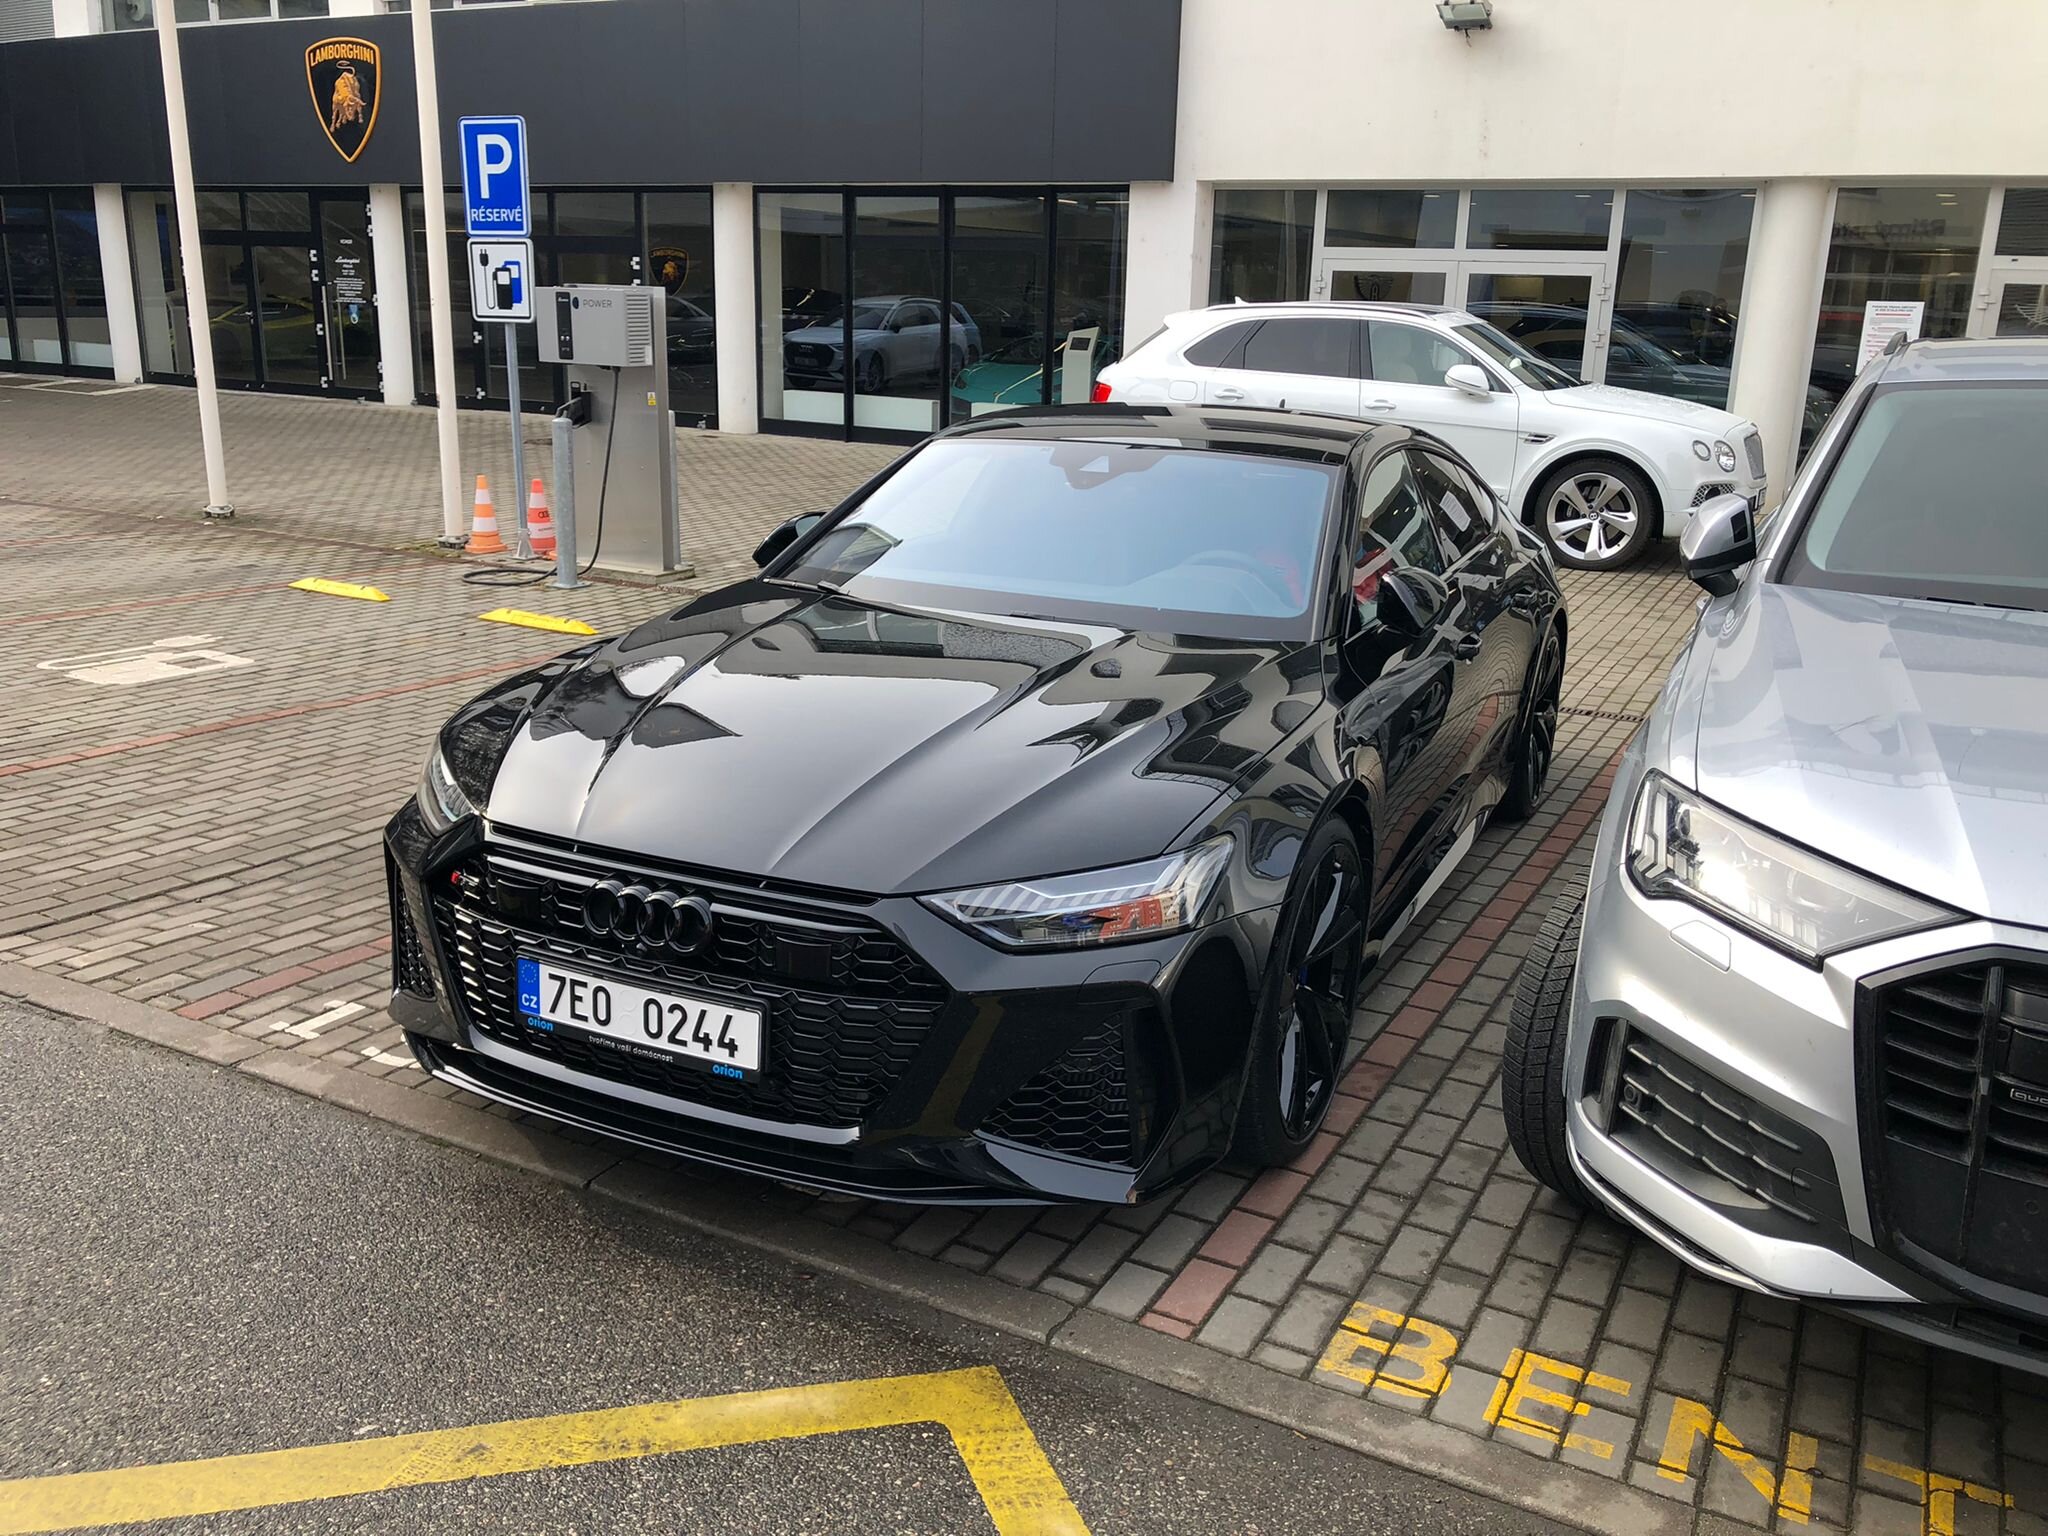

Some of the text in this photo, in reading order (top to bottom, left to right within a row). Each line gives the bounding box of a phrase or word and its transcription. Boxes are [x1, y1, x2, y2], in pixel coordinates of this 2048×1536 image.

[310, 44, 374, 67] LAMBORGHINI
[477, 134, 512, 199] P
[470, 205, 522, 222] RÉSERVÉ
[583, 300, 613, 308] POWER
[521, 993, 538, 1009] CZ
[548, 972, 739, 1058] 7E0 0244
[527, 1017, 554, 1031] orion
[633, 1047, 674, 1063] domácnost
[712, 1063, 744, 1080] orion
[1311, 1301, 2015, 1536] BENT
